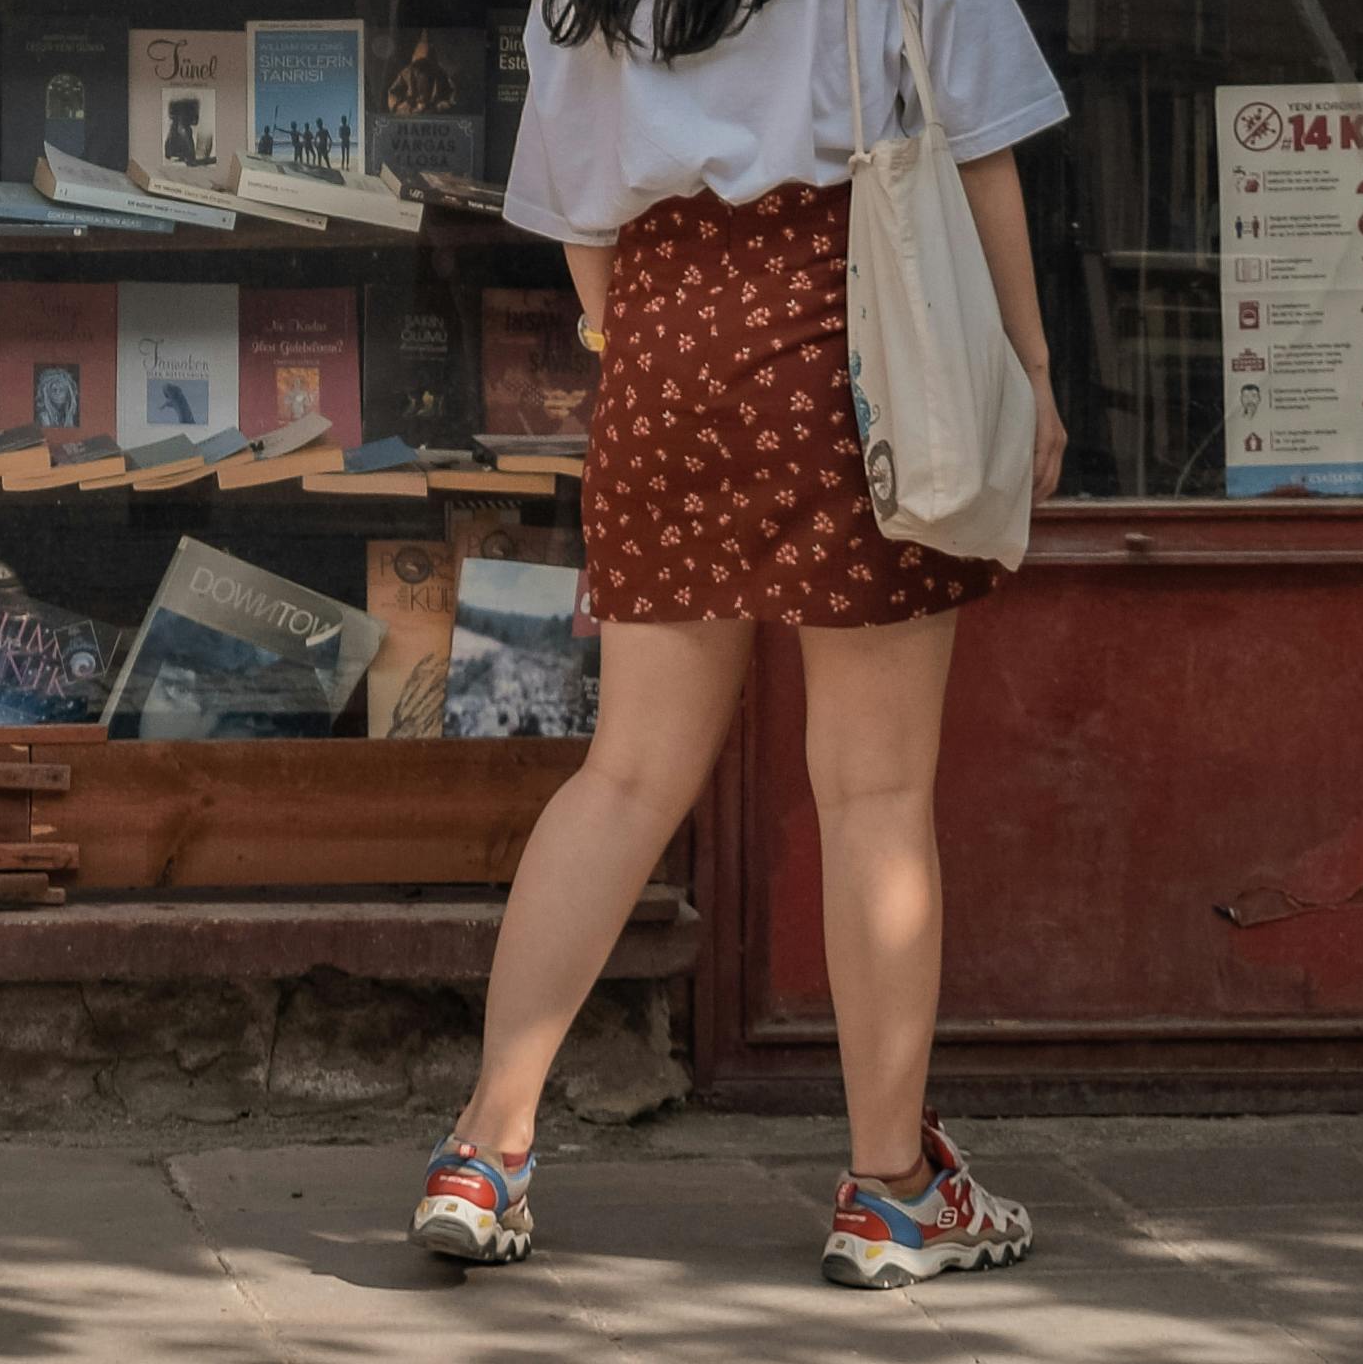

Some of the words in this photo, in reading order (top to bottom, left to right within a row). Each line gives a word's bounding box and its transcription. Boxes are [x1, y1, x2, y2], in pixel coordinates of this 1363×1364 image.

[147, 38, 218, 81] Tünel
[259, 53, 355, 69] SİNEKLERİN
[259, 68, 324, 83] TANRISI
[1288, 113, 1332, 152] 14
